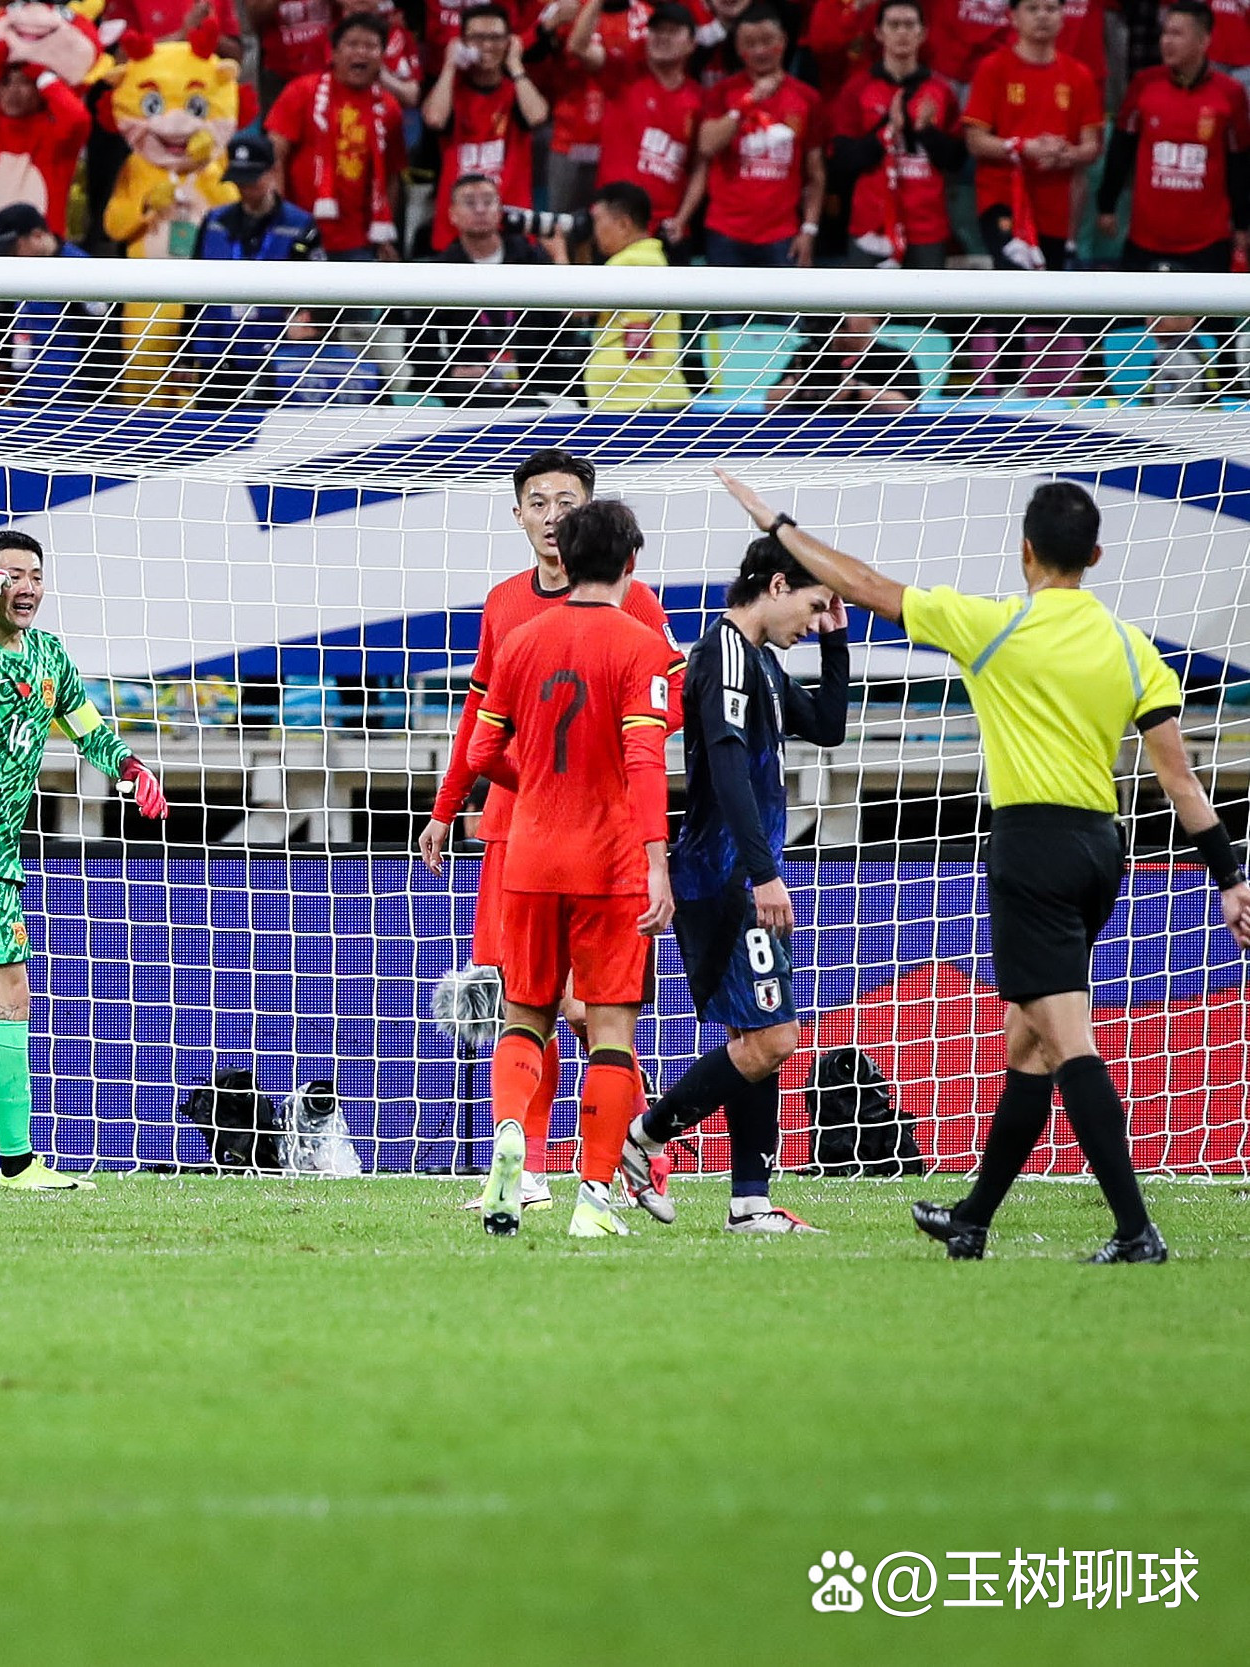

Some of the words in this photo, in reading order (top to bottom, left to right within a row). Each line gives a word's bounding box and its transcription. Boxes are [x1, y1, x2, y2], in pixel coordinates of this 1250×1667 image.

[8, 713, 36, 755] 14
[540, 670, 587, 774] 7
[745, 927, 775, 975] 8
